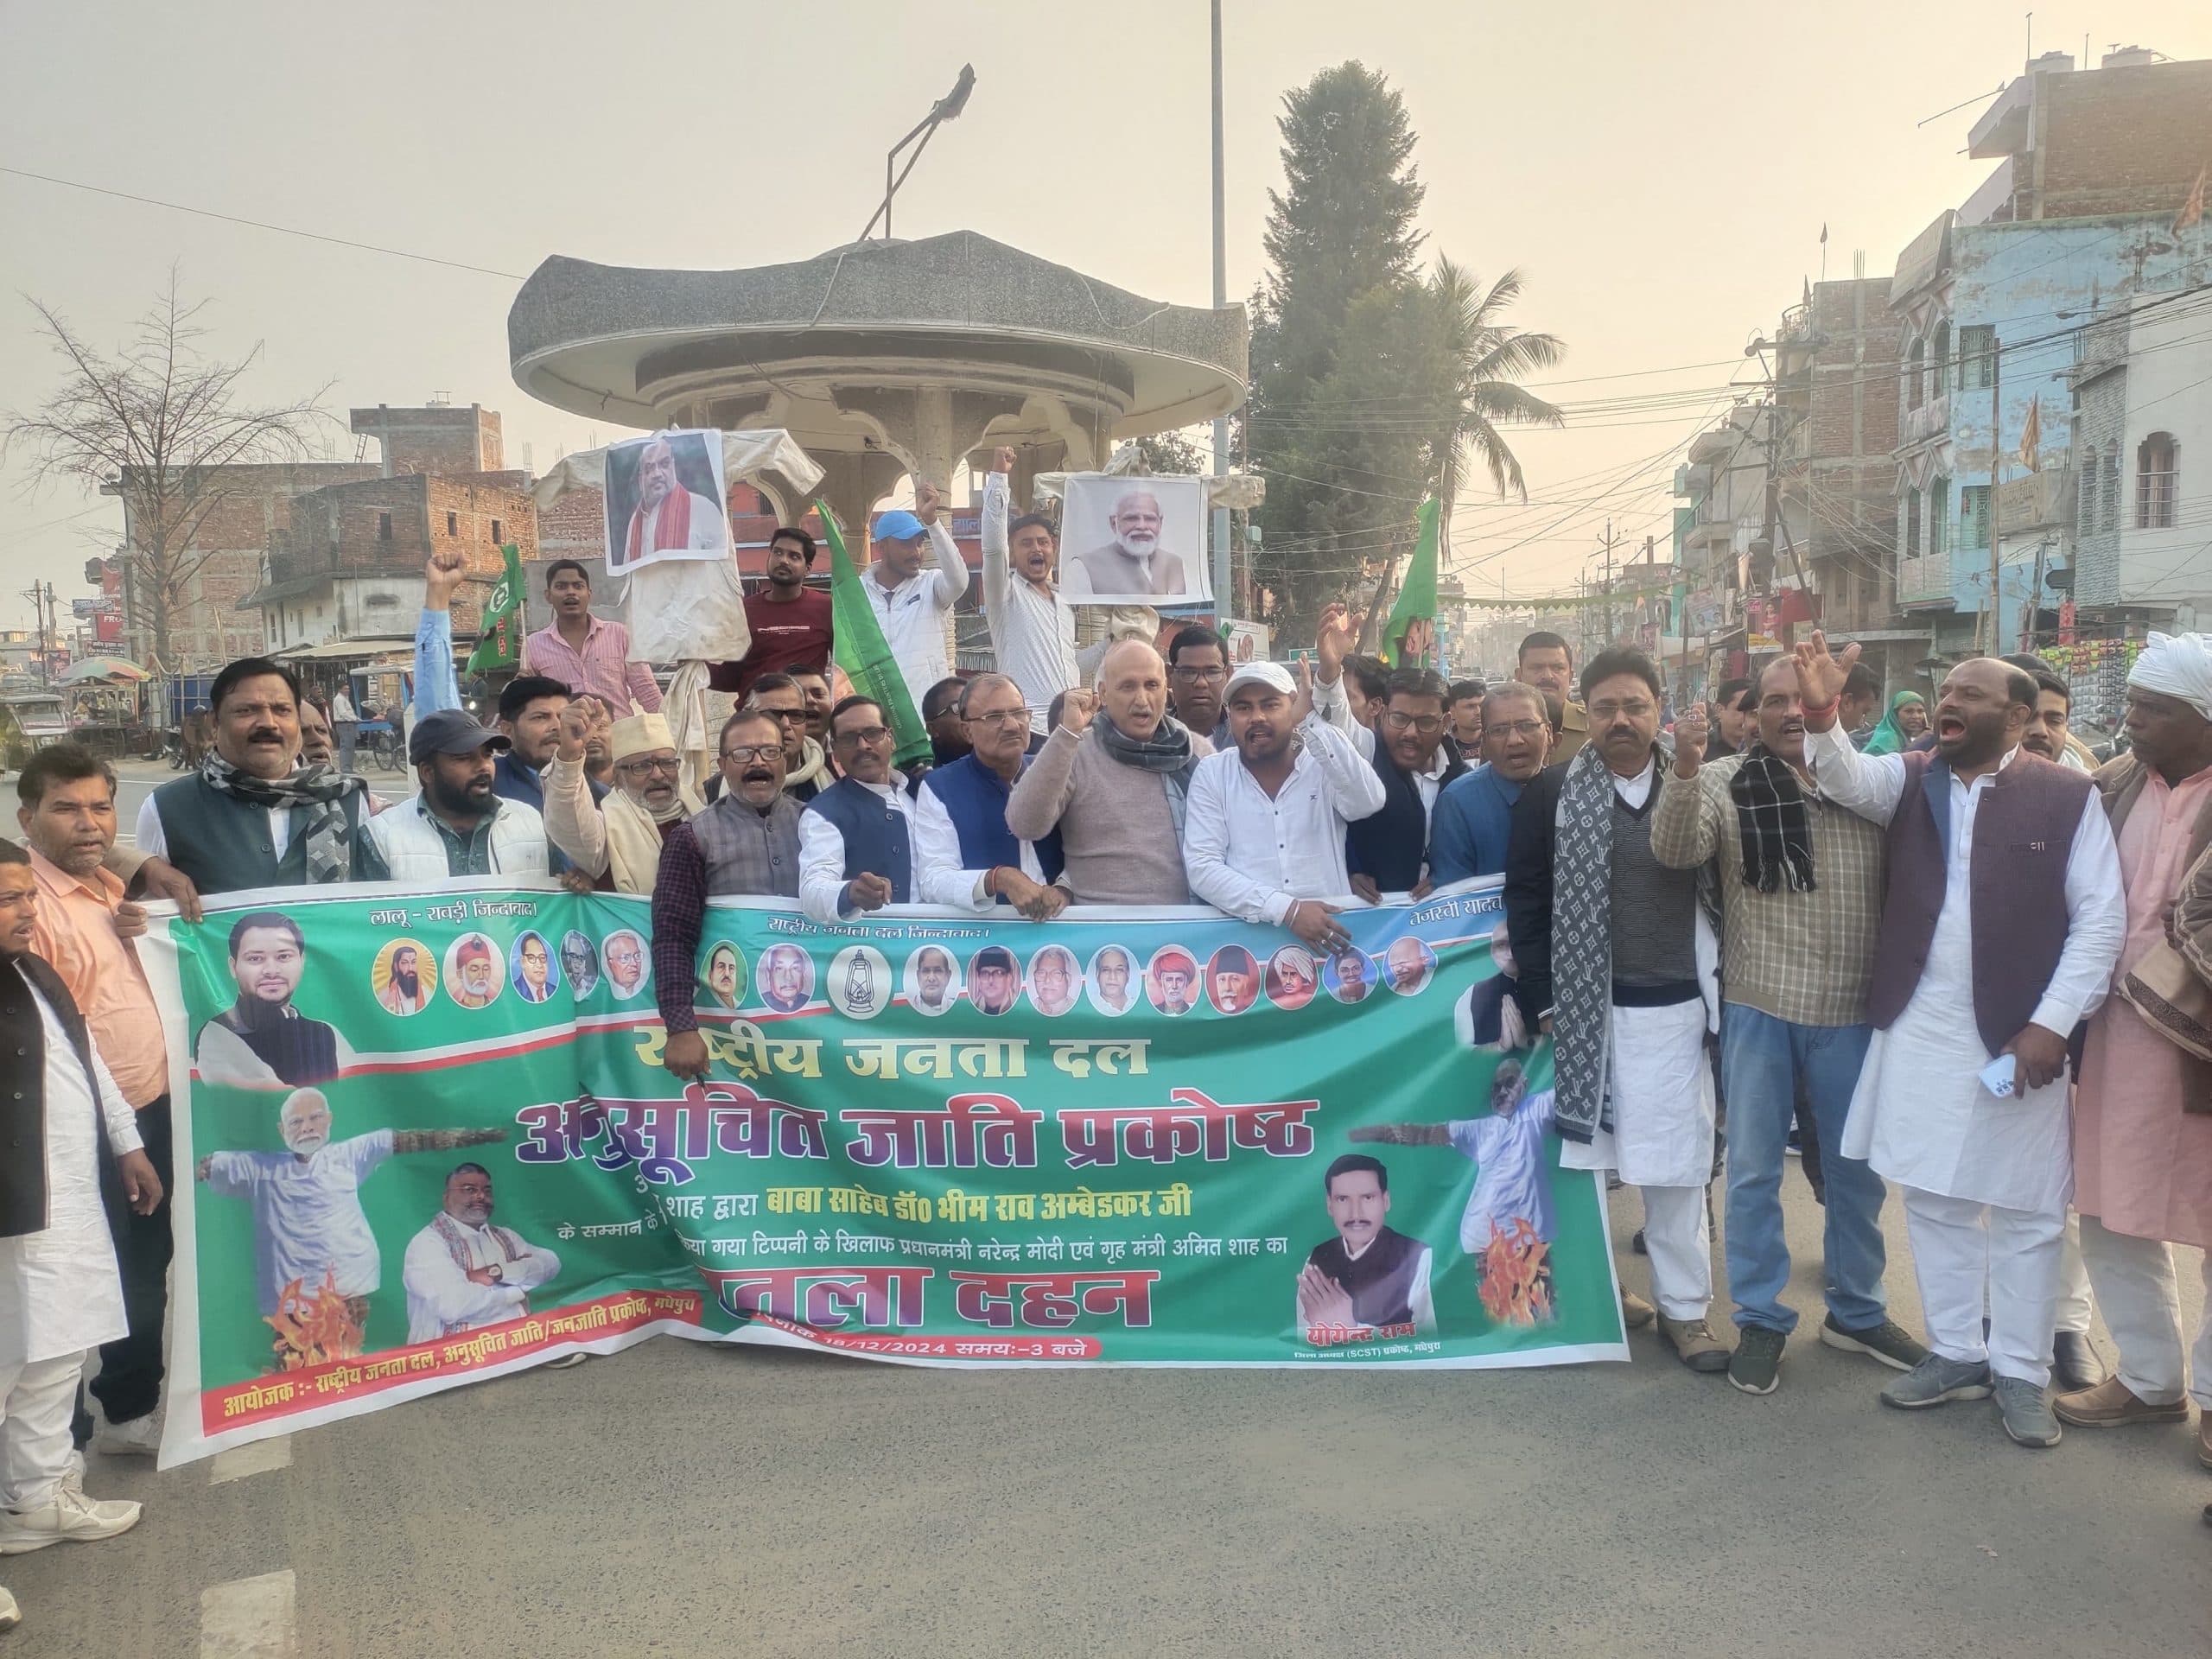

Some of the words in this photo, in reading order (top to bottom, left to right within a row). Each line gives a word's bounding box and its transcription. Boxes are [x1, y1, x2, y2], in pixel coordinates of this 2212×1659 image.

[369, 908, 412, 929] लालू
[768, 917, 817, 936] राष्ट्रीय
[823, 925, 869, 938] जनता
[874, 926, 903, 939] दल
[1409, 900, 1460, 926] तेजस्वी
[1463, 895, 1503, 915] यादव
[633, 1019, 823, 1080] रष्ट्रीय
[842, 1037, 1030, 1079] जनता
[1049, 1037, 1152, 1079] दल
[840, 1092, 1045, 1169] जाति
[1056, 1087, 1321, 1170] प्रकोष्ठ
[665, 1195, 706, 1220] शाह
[712, 1194, 759, 1221] द्वारा
[766, 1187, 823, 1215] बाबा
[828, 1183, 888, 1217] साहेब
[938, 1188, 989, 1223] भीम
[995, 1194, 1035, 1222] राव
[1041, 1186, 1154, 1221] अम्बेडकर
[1156, 1182, 1193, 1217] जी
[556, 1223, 575, 1242] के
[580, 1219, 642, 1238] सम्मान
[711, 1238, 747, 1257] गया
[753, 1230, 809, 1256] टिप्पनी
[813, 1229, 830, 1254] के
[836, 1230, 895, 1255] खिलाफ
[899, 1236, 973, 1262] प्रधानमंत्री
[977, 1237, 1020, 1263] नरेन्द्र
[1027, 1235, 1065, 1262] मोदी
[1071, 1236, 1095, 1261] एवं
[1101, 1238, 1127, 1265] गृह
[1133, 1235, 1166, 1259] मंत्री
[1173, 1231, 1222, 1258] अमित
[1228, 1236, 1261, 1257] शाह
[1266, 1236, 1287, 1255] का
[949, 1269, 1161, 1329] दहन
[1051, 1338, 1090, 1357] बजे
[1377, 1322, 1417, 1339] राम
[223, 1382, 295, 1417] आयोजक
[315, 1366, 362, 1395] राष्ट्रीय
[365, 1357, 407, 1382] जनता
[410, 1350, 442, 1370] दल,
[444, 1330, 507, 1366] अनुसूचित
[655, 1295, 696, 1314] मधेपुरा
[1347, 1347, 1381, 1359] (SCST)
